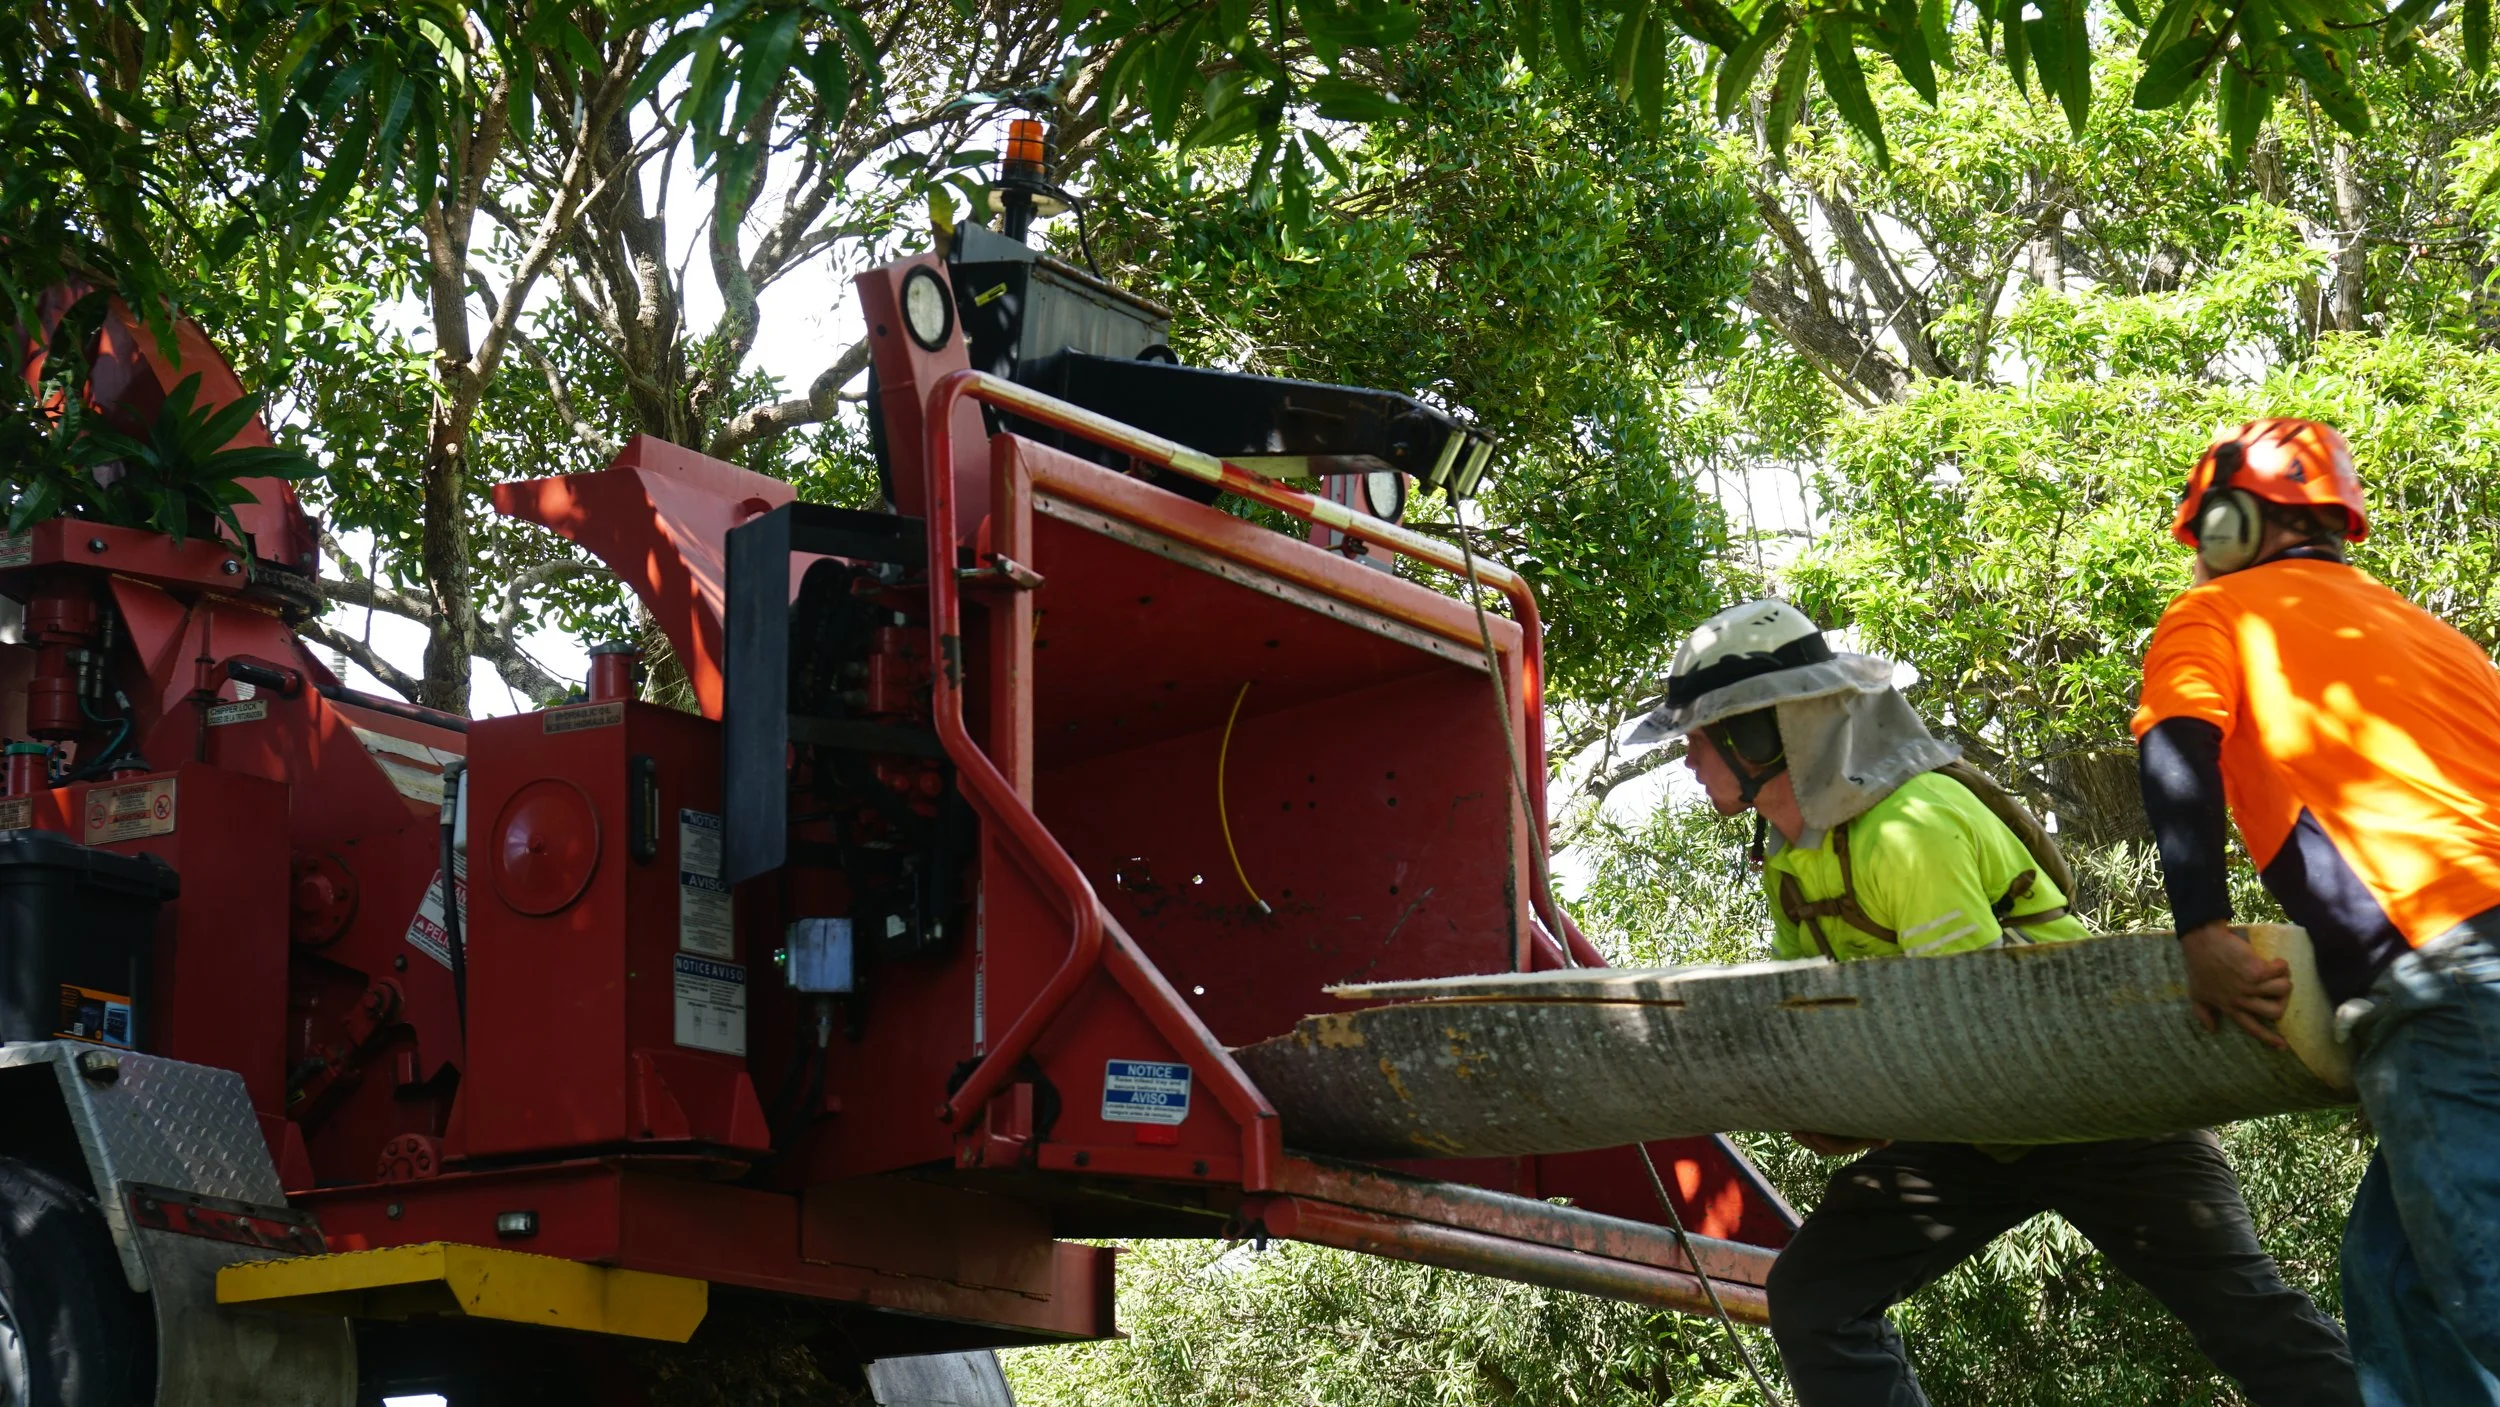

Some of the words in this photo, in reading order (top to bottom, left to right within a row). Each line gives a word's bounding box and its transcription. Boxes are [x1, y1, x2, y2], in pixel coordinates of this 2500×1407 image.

[210, 705, 238, 715] CHIPPER
[239, 702, 256, 712] LOCK
[689, 814, 720, 830] NOTIC
[675, 957, 710, 975] NOTICE
[711, 964, 744, 981] AVISO
[1127, 1064, 1173, 1078] NOTICE
[1130, 1091, 1168, 1105] AVISO
